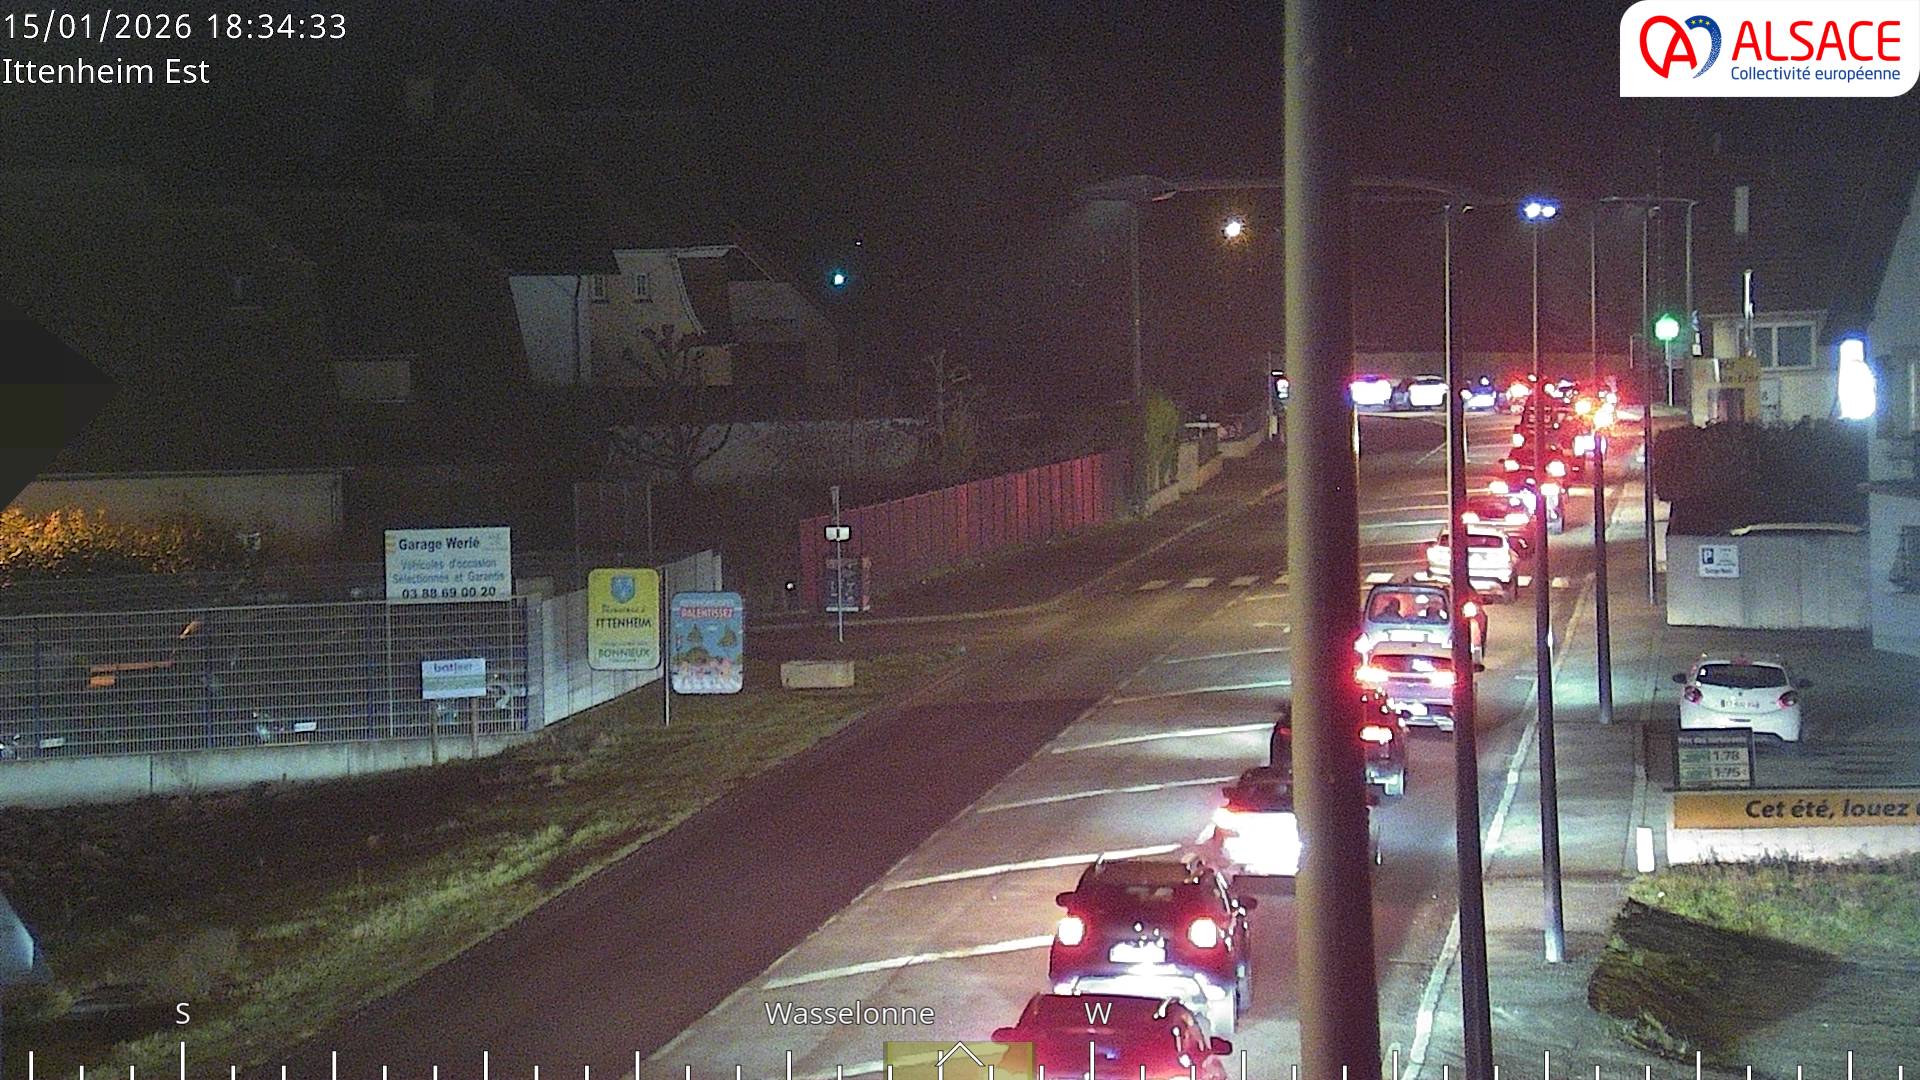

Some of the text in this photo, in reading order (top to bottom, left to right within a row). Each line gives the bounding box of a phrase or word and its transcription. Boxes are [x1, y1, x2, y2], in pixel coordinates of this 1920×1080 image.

[399, 538, 442, 553] Garage
[402, 586, 497, 600] 03 88 69 00 20
[596, 617, 652, 628] ITTENHEIM
[1745, 799, 1787, 818] Cet
[1791, 798, 1835, 820] été,
[1843, 799, 1910, 817] louez
